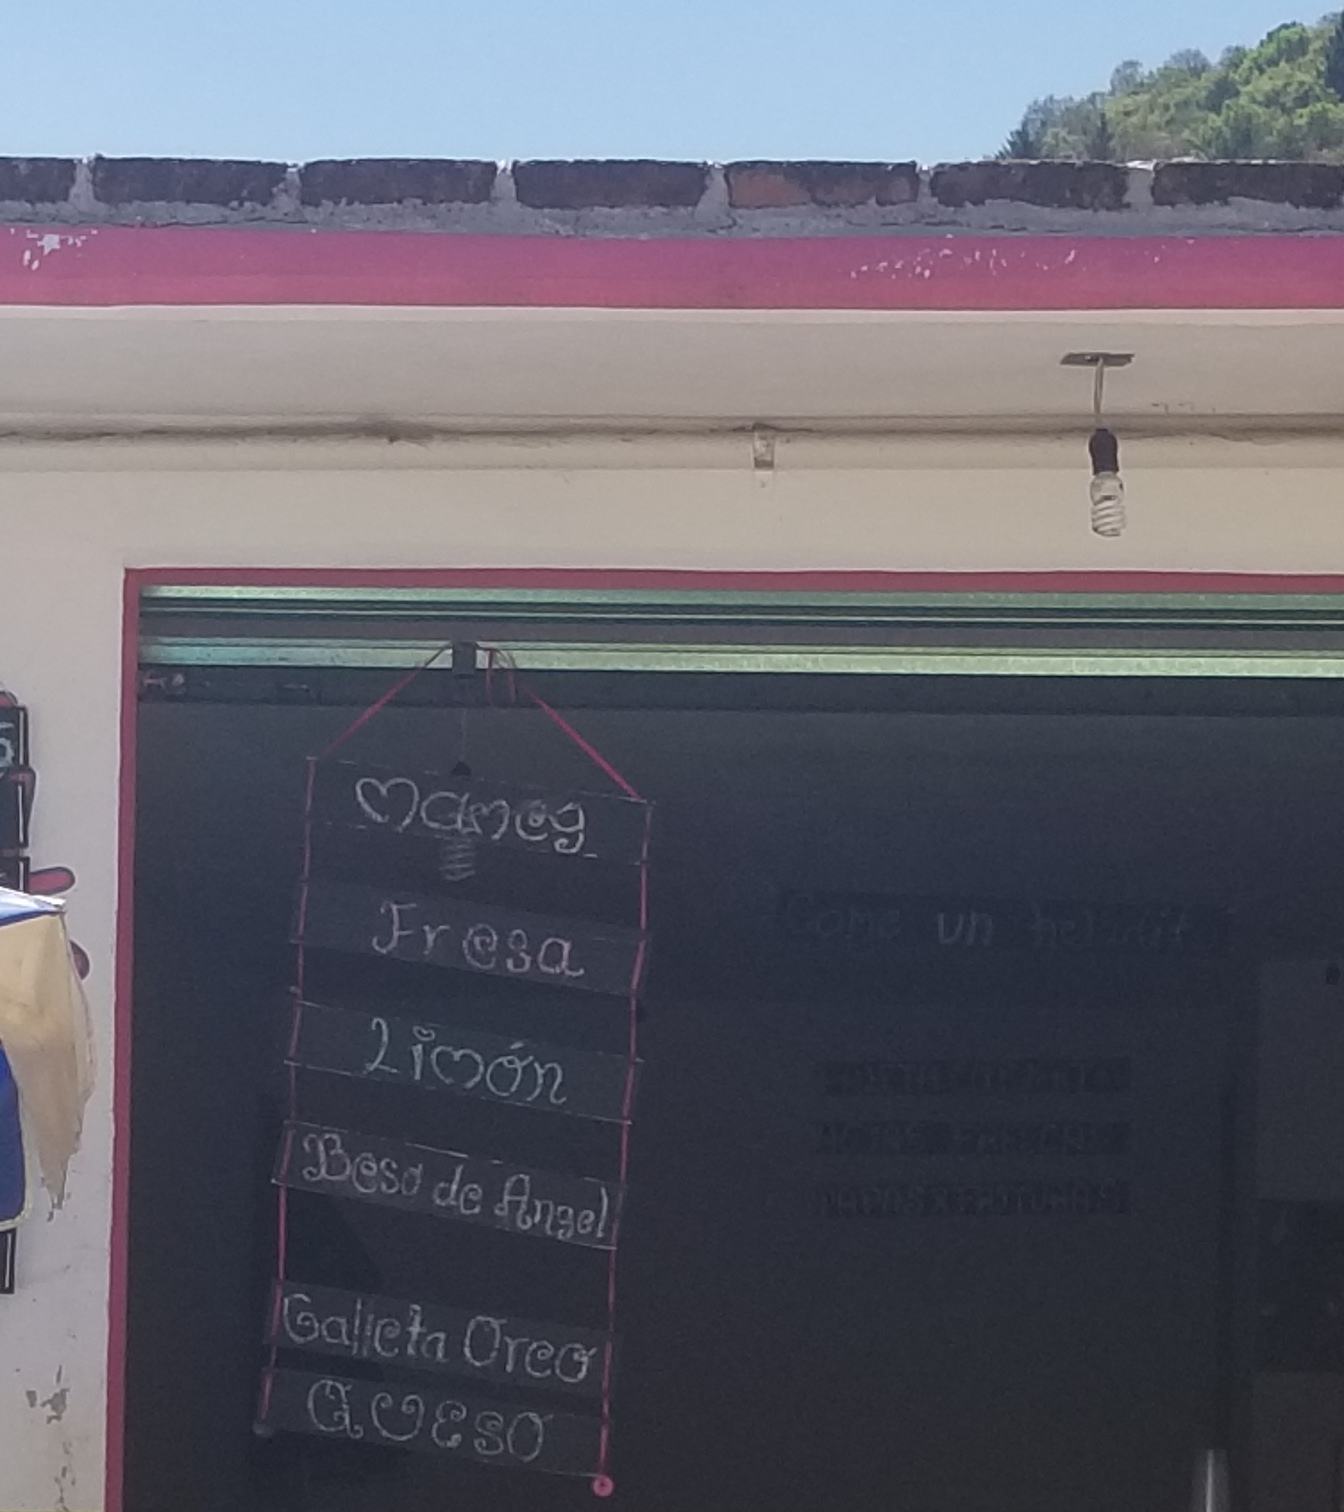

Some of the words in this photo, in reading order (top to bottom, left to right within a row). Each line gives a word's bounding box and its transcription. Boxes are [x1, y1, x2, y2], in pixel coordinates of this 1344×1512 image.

[355, 776, 591, 855] Mamey
[371, 901, 585, 978] Fresa
[364, 1016, 568, 1104] Limón
[301, 1132, 424, 1196] Beso
[432, 1163, 484, 1216] de
[493, 1173, 610, 1240] Angel
[462, 1314, 599, 1383] Oreo
